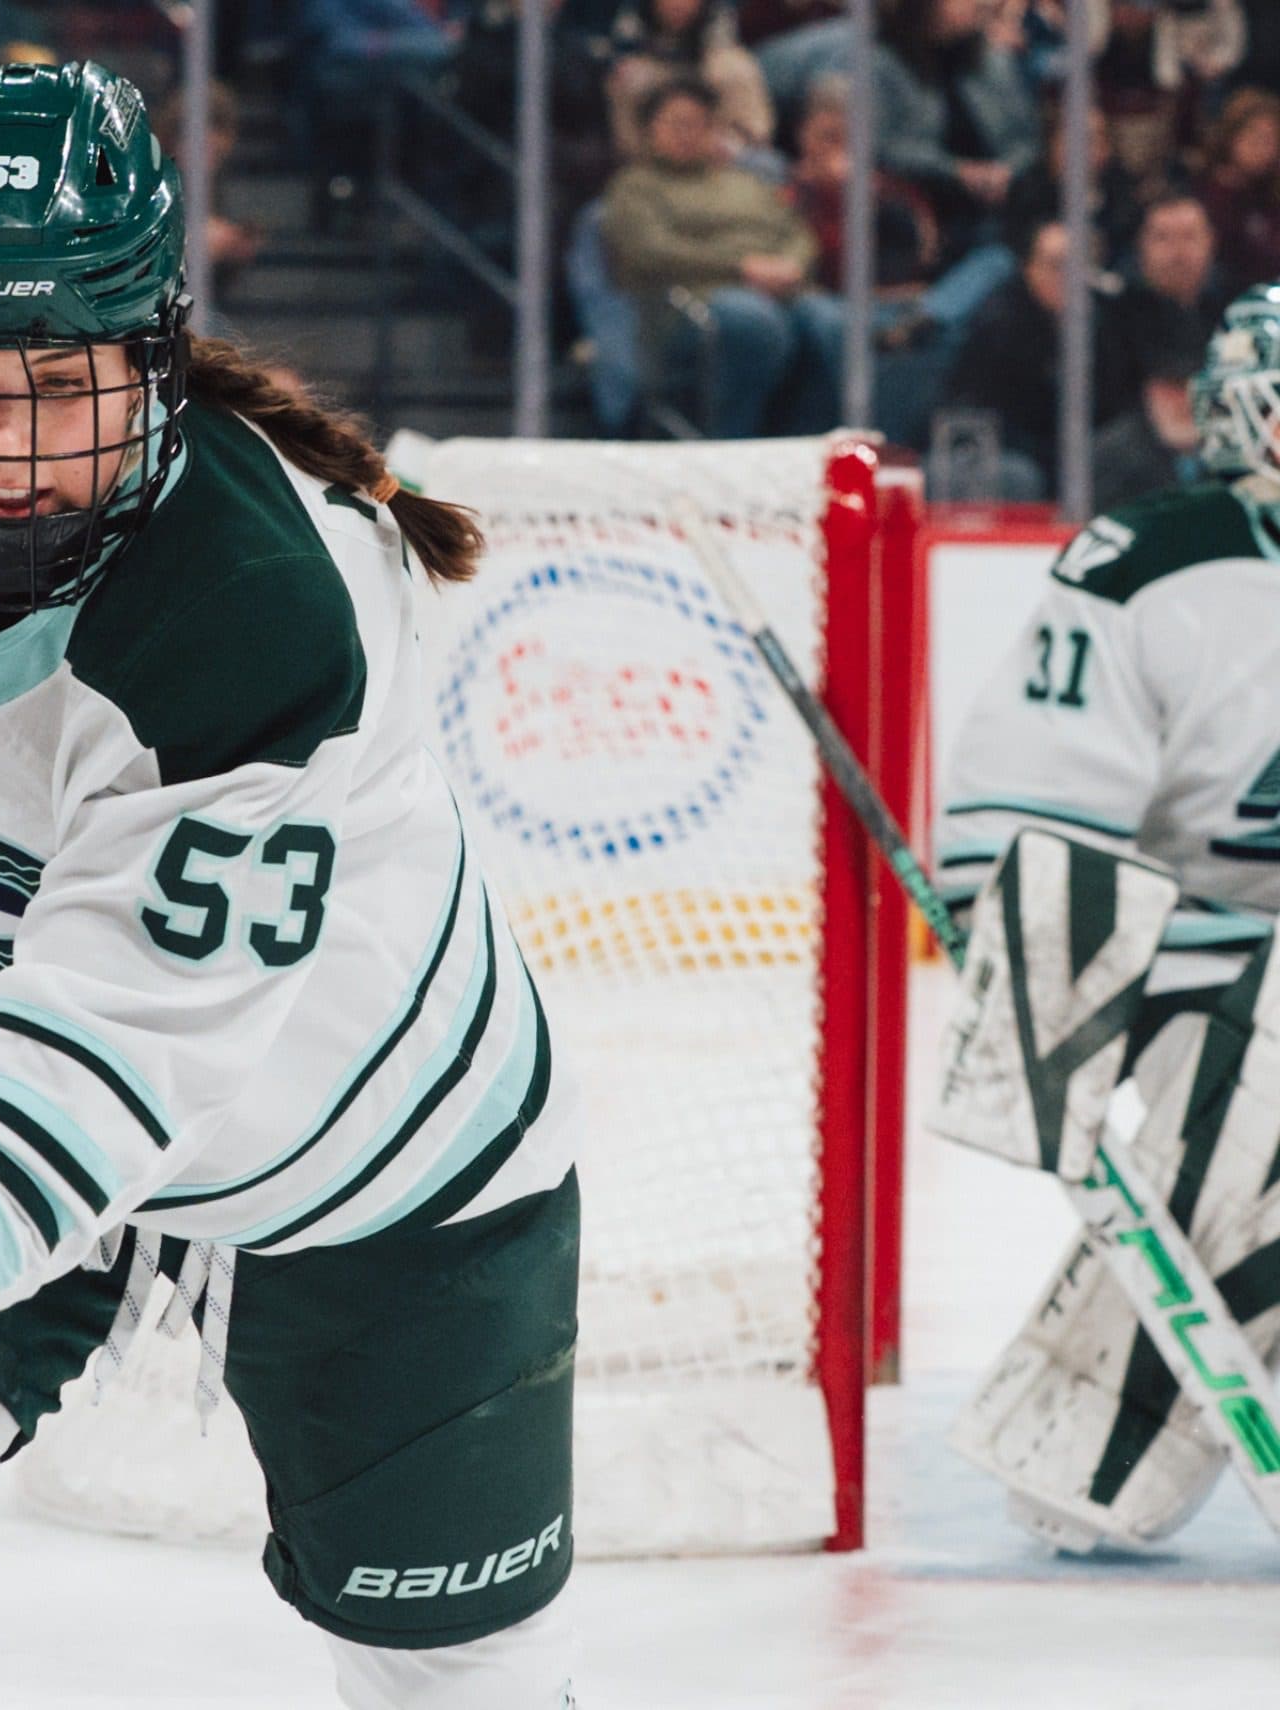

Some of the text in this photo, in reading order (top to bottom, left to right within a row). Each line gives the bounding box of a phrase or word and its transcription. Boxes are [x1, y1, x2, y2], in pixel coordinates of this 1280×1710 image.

[1026, 625, 1090, 708] 31
[139, 815, 337, 970] 53
[336, 1513, 564, 1602] BAUER
